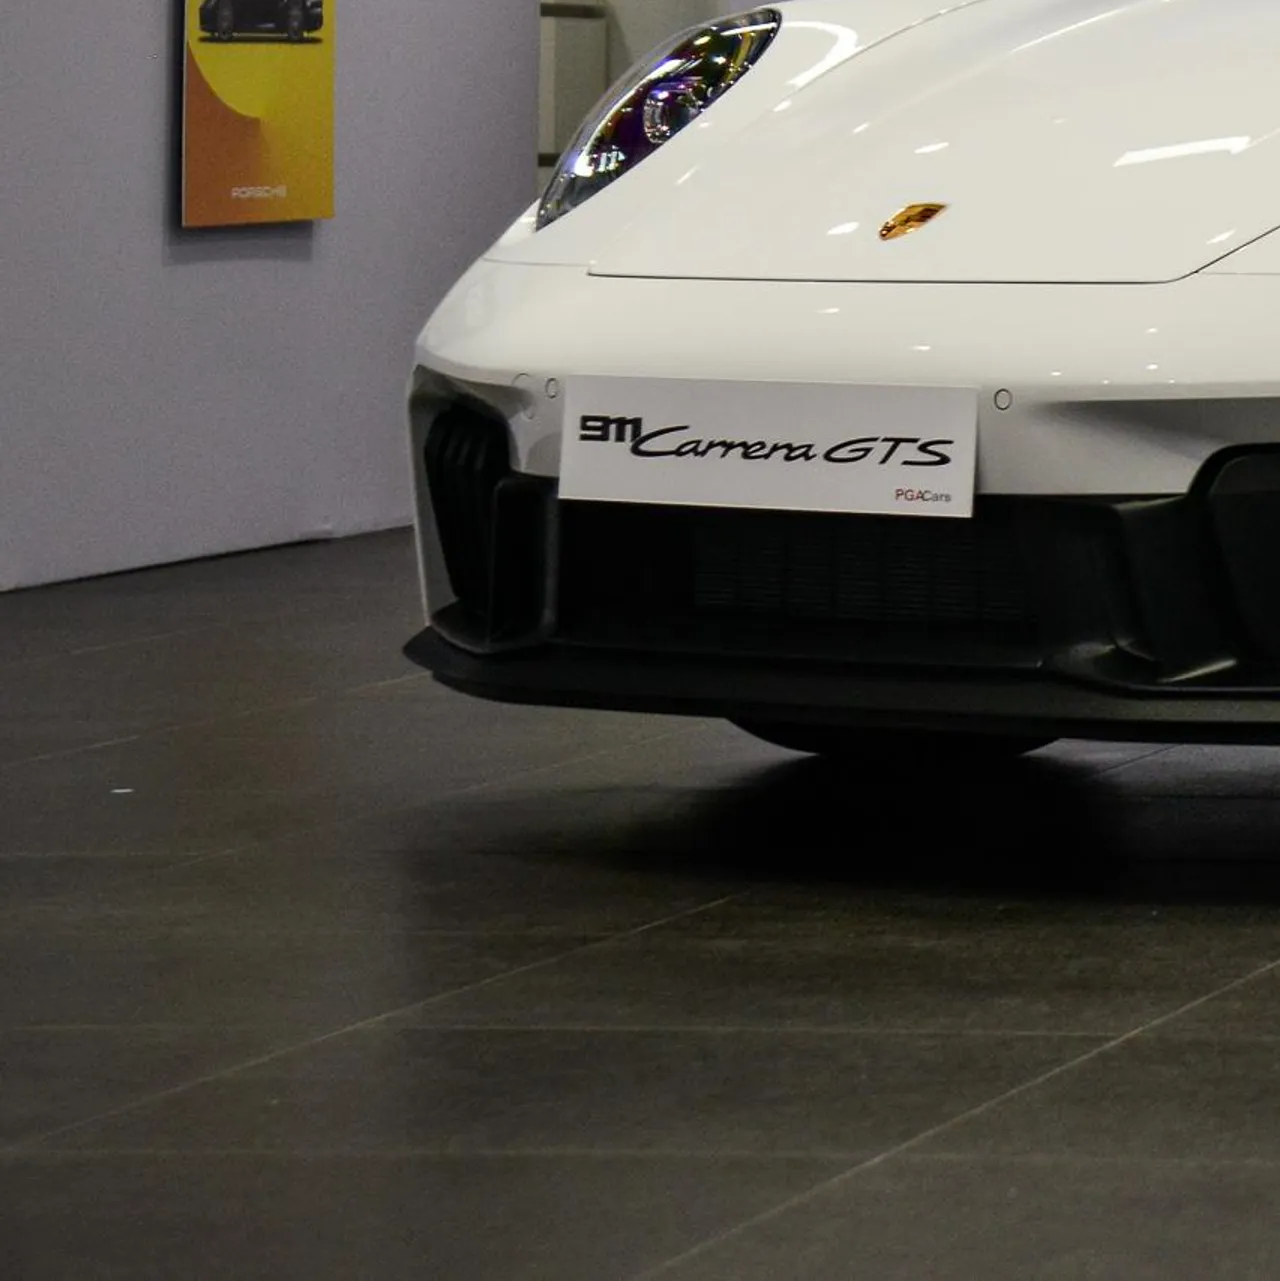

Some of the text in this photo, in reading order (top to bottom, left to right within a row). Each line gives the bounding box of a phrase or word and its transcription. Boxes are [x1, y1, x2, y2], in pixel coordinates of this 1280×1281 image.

[579, 415, 955, 467] 911 Carrera GTS
